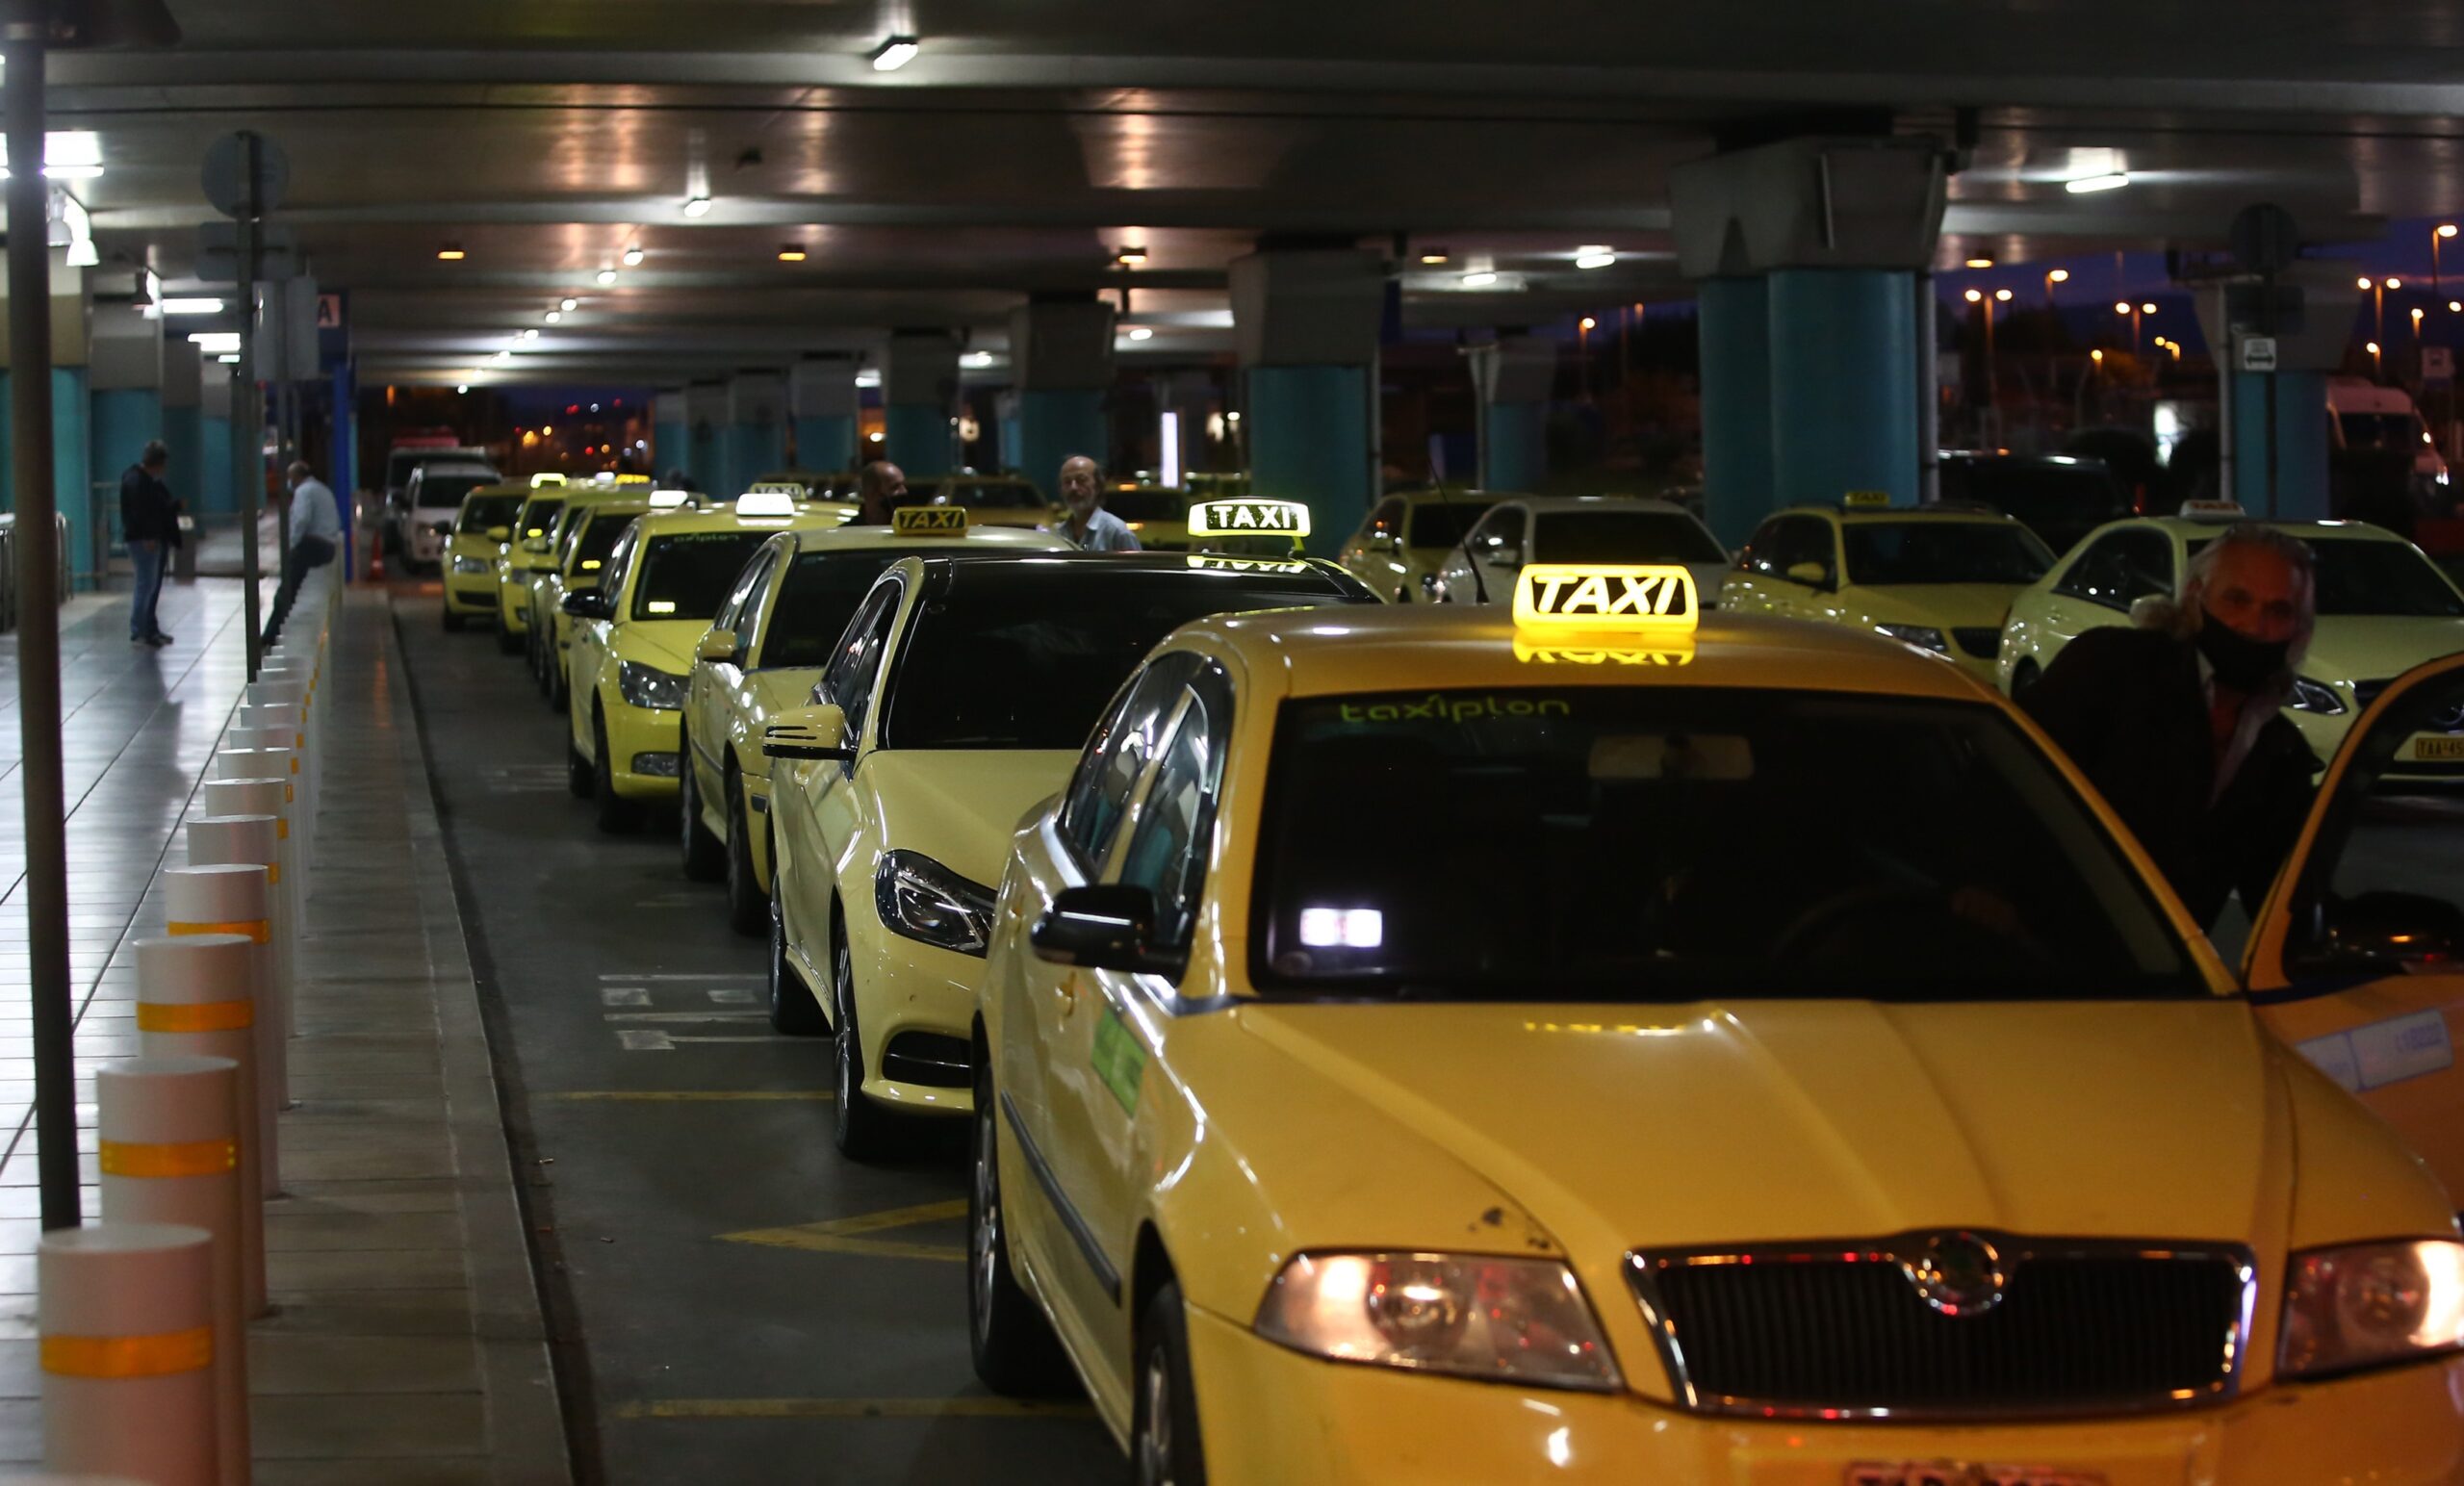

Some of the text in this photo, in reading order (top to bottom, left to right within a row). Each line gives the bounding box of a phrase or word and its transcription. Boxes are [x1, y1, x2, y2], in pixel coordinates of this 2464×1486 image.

[902, 511, 961, 528] TAXI
[1213, 505, 1291, 528] TAXI
[1534, 575, 1679, 615] TAXI
[1340, 693, 1571, 724] taxiplon
